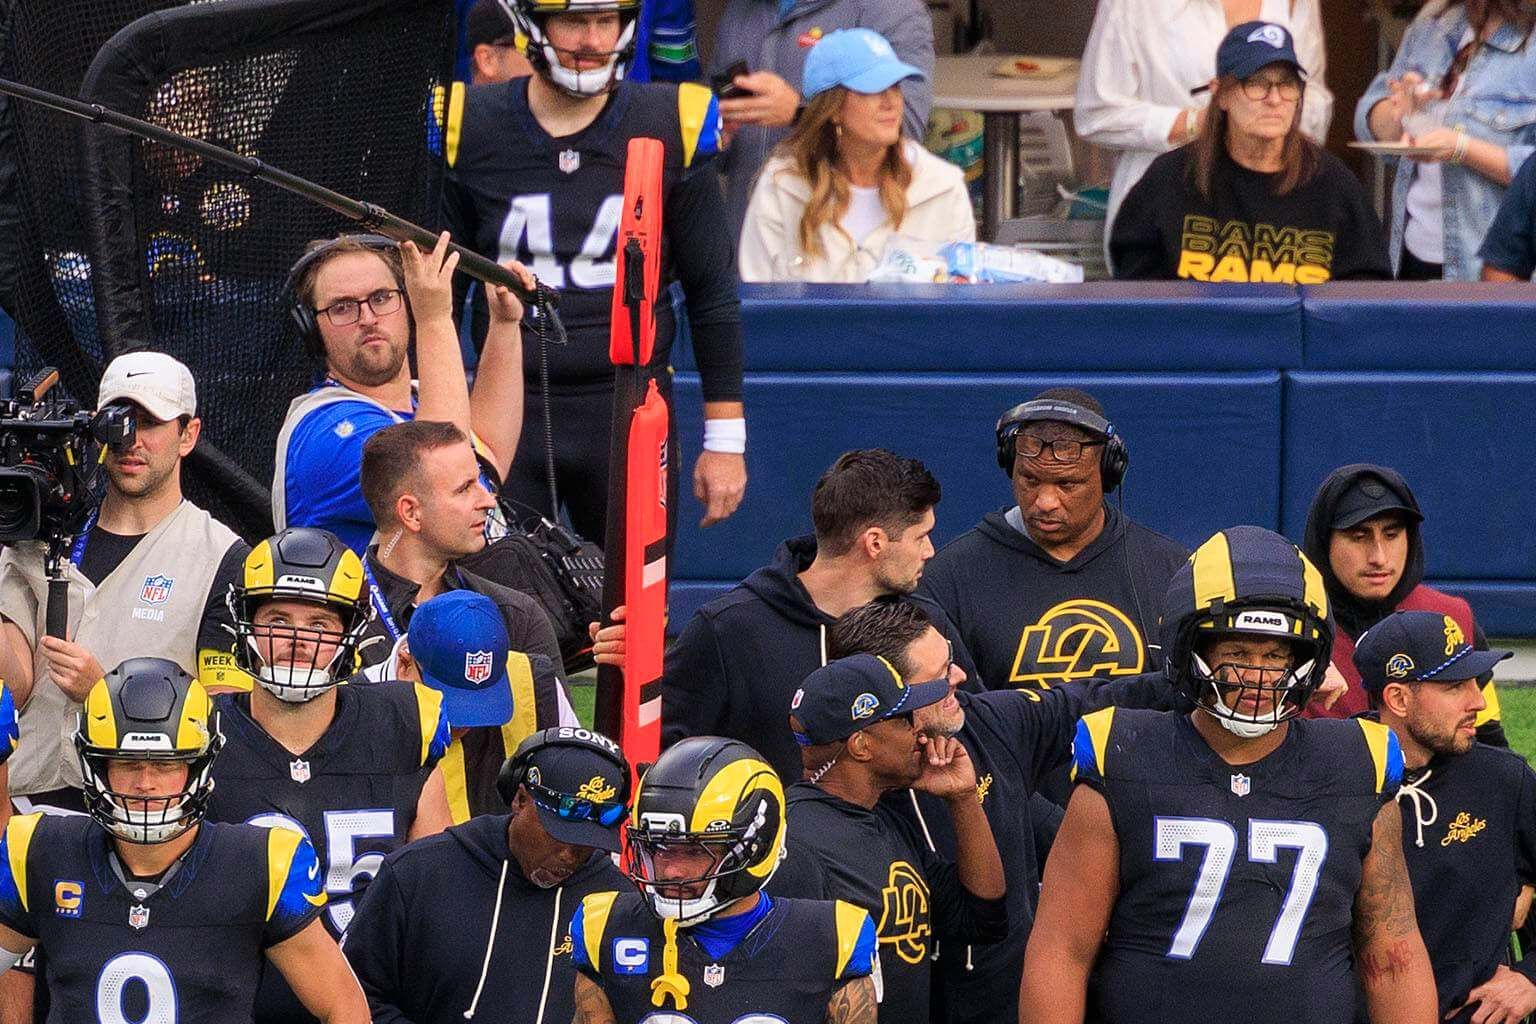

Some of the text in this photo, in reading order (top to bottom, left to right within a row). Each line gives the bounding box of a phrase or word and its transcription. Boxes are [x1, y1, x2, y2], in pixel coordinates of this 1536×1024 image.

[1178, 250, 1331, 285] RAMS
[286, 576, 316, 584] RAMS
[132, 608, 164, 621] MEDIA
[1244, 616, 1282, 626] RAMS
[204, 656, 232, 666] WEEK
[559, 728, 620, 753] SONY
[56, 882, 81, 908] C
[1154, 815, 1329, 967] 77
[616, 940, 646, 965] C
